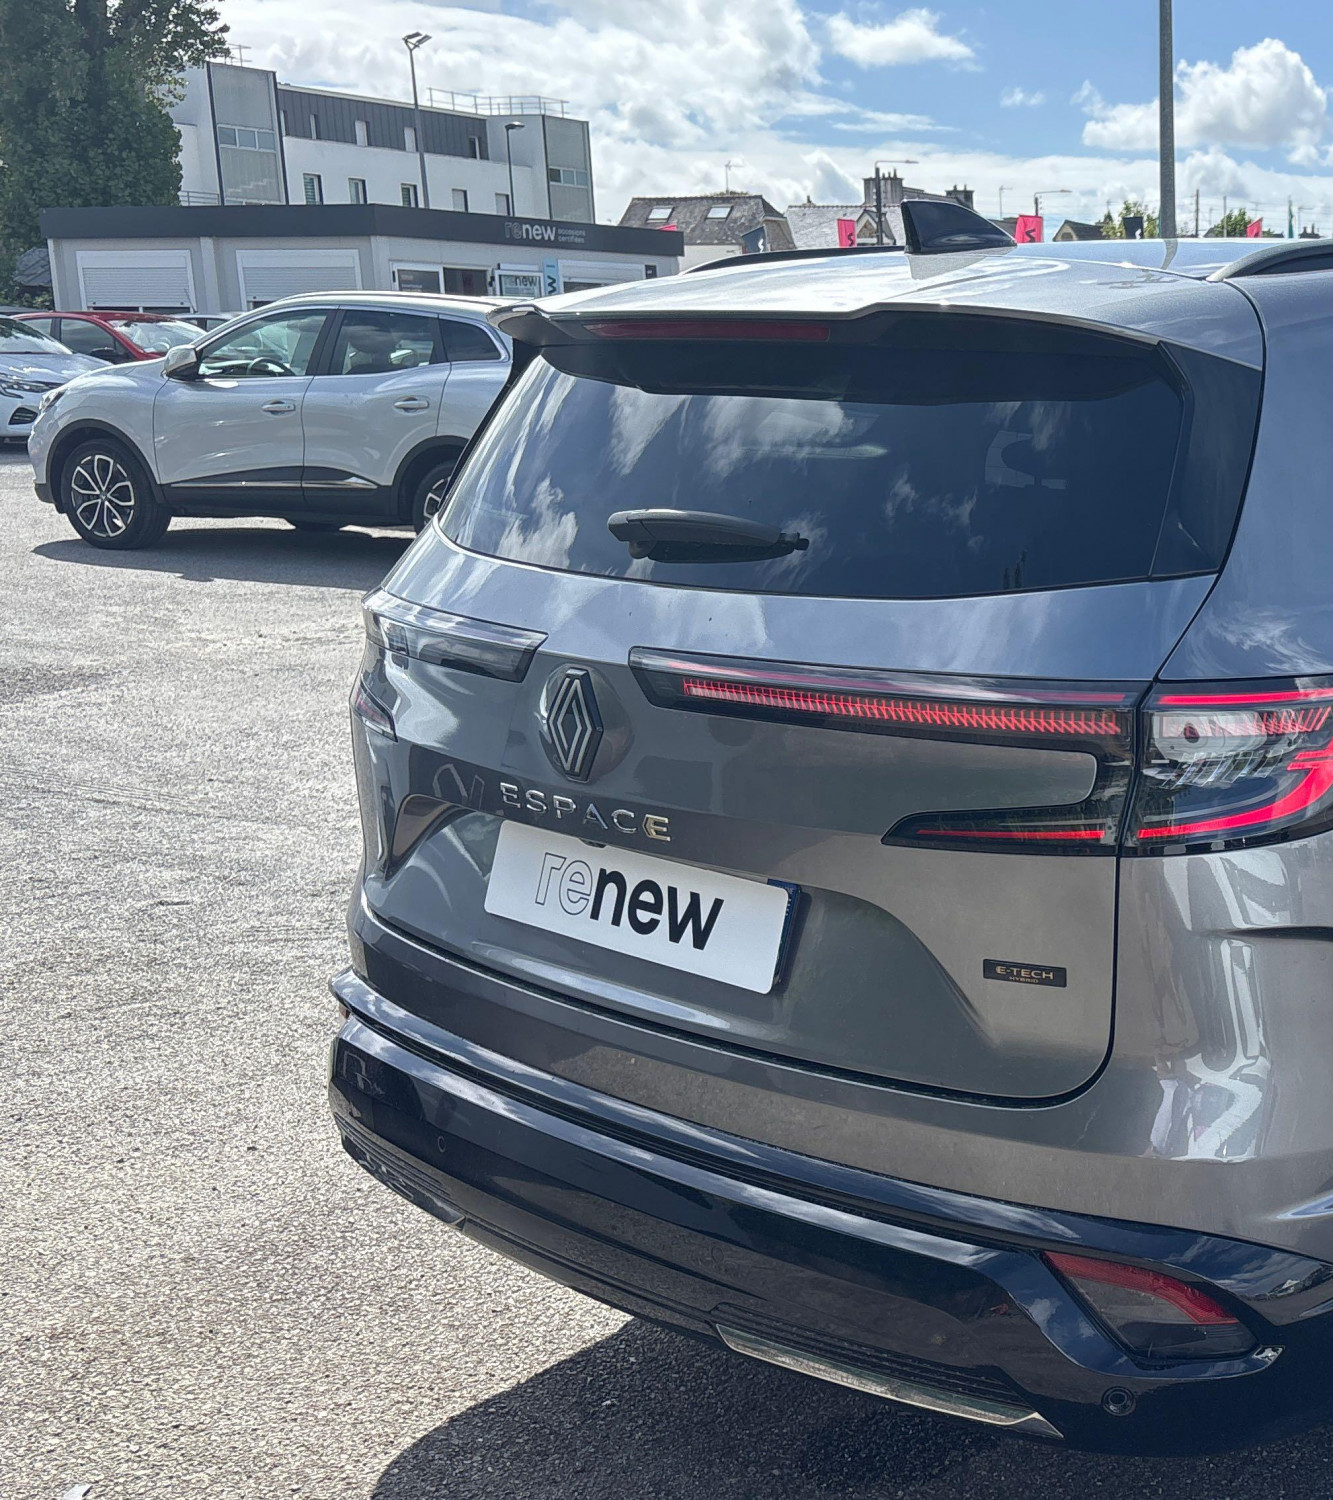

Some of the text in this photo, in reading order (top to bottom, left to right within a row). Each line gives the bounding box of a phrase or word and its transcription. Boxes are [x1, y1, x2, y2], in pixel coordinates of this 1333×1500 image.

[504, 222, 556, 241] renew
[499, 782, 672, 842] ESPACE
[535, 852, 725, 951] renew
[995, 965, 1054, 980] E-TECH
